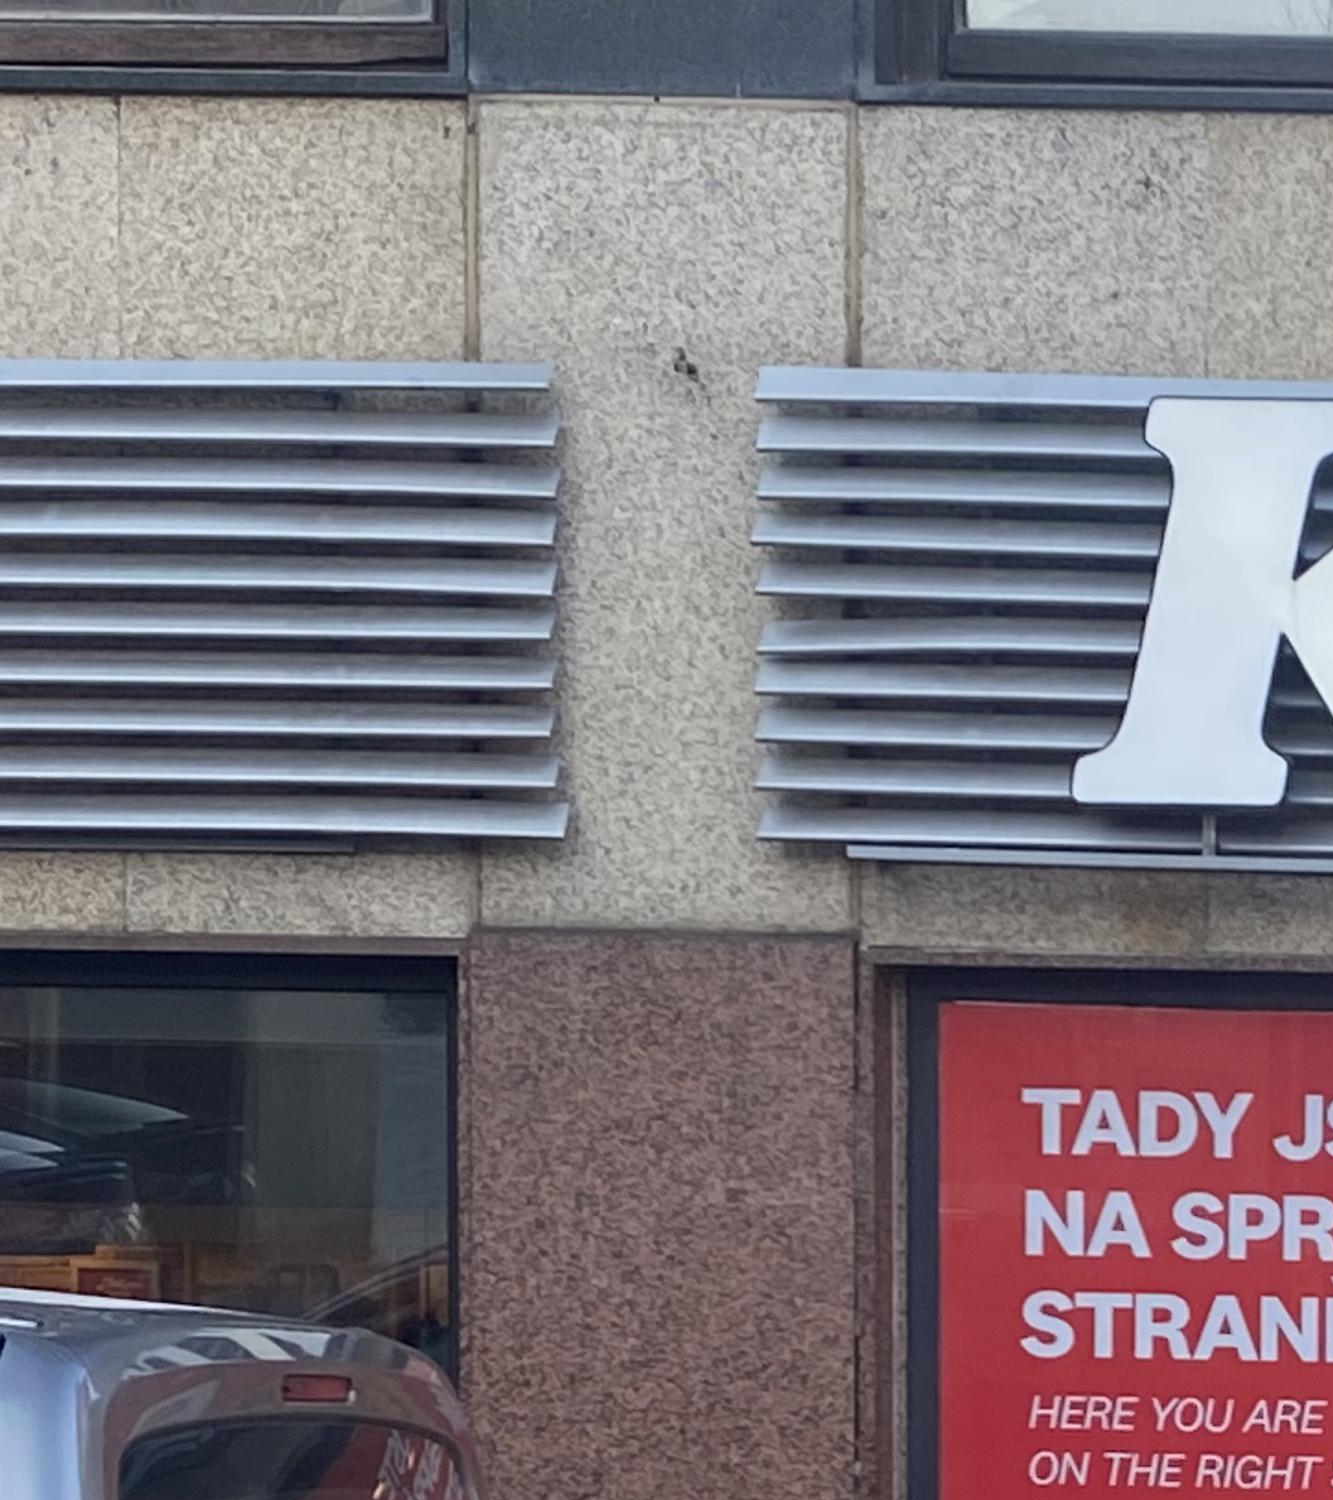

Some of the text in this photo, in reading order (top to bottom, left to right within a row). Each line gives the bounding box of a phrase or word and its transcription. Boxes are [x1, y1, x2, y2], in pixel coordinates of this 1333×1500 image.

[1021, 1088, 1253, 1159] TADY
[1025, 1189, 1151, 1258] NA
[1028, 1395, 1328, 1435] HERE YOU ARE
[1028, 1451, 1091, 1486] ON
[1103, 1453, 1186, 1488] THE
[1195, 1455, 1322, 1490] RIGHT
